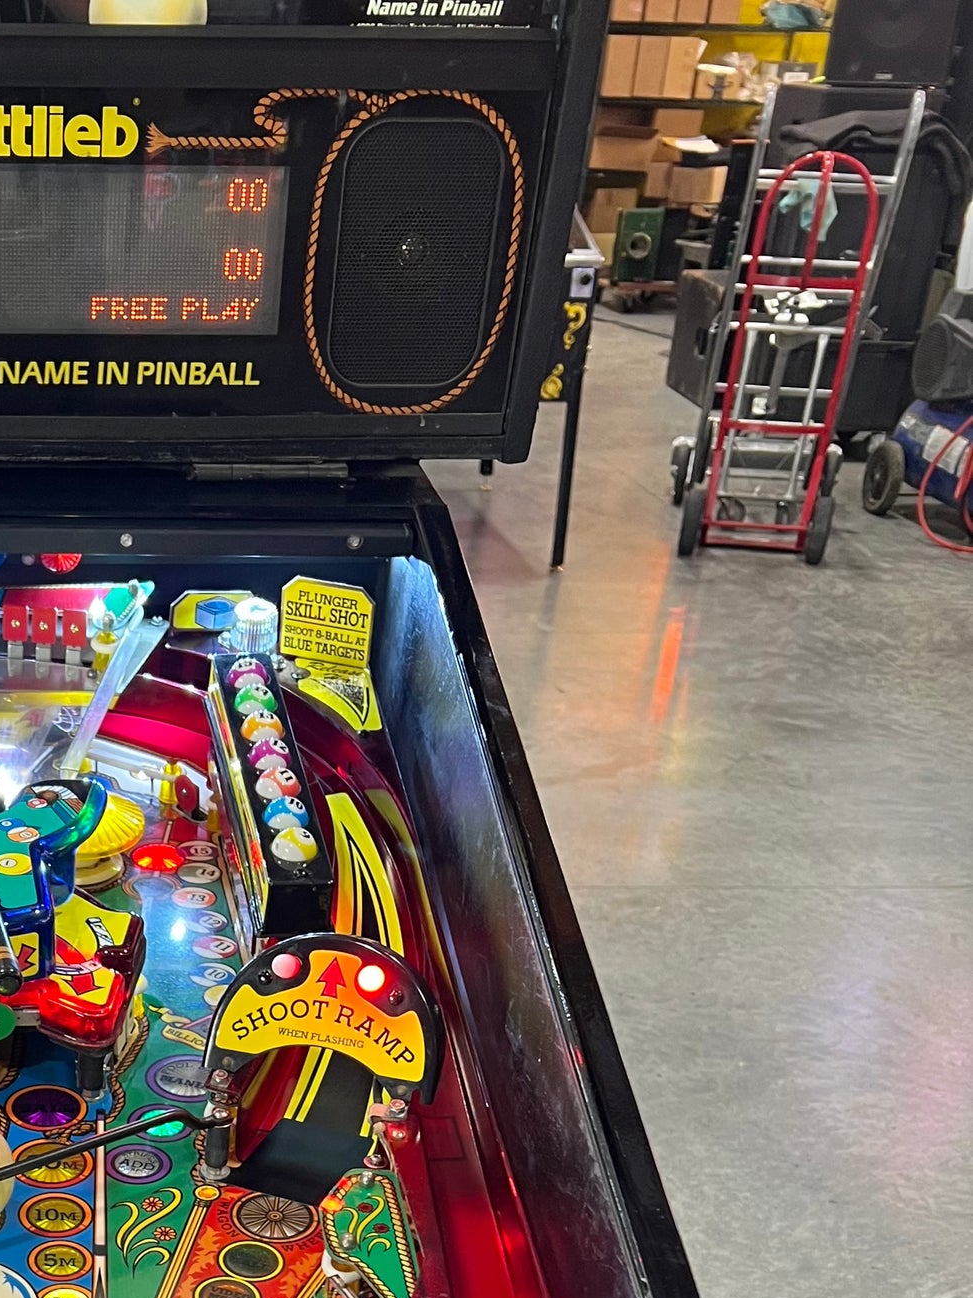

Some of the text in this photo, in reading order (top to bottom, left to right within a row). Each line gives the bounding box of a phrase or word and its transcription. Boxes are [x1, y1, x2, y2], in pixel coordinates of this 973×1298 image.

[366, 0, 504, 17] Name in Pinball
[228, 177, 269, 213] 00
[224, 248, 265, 281] 00
[90, 297, 260, 321] FREE PLAY
[97, 361, 129, 386] IN
[136, 361, 261, 387] PINBALL
[298, 590, 358, 610] PLUNGER
[285, 601, 369, 629] SKILL SHOT
[284, 625, 367, 647] SHOOT 8-BALL AT
[283, 636, 365, 661] BLUE TARGETS
[279, 769, 294, 783] 11
[193, 847, 209, 856] 15
[200, 868, 215, 877] 14
[190, 893, 206, 902] 13
[206, 916, 221, 927] 12
[214, 941, 231, 952] 11
[210, 969, 226, 979] 10
[164, 1027, 207, 1047] BILLIO
[231, 999, 416, 1065] SHOOT RAMP
[278, 1027, 365, 1049] WHEN FLASHING
[158, 1074, 208, 1090] MANI
[119, 1158, 156, 1171] ADD
[34, 1207, 77, 1222] 10M
[216, 1200, 239, 1239] WAGON
[281, 1231, 324, 1252] WHEE
[44, 1253, 77, 1268] 5M
